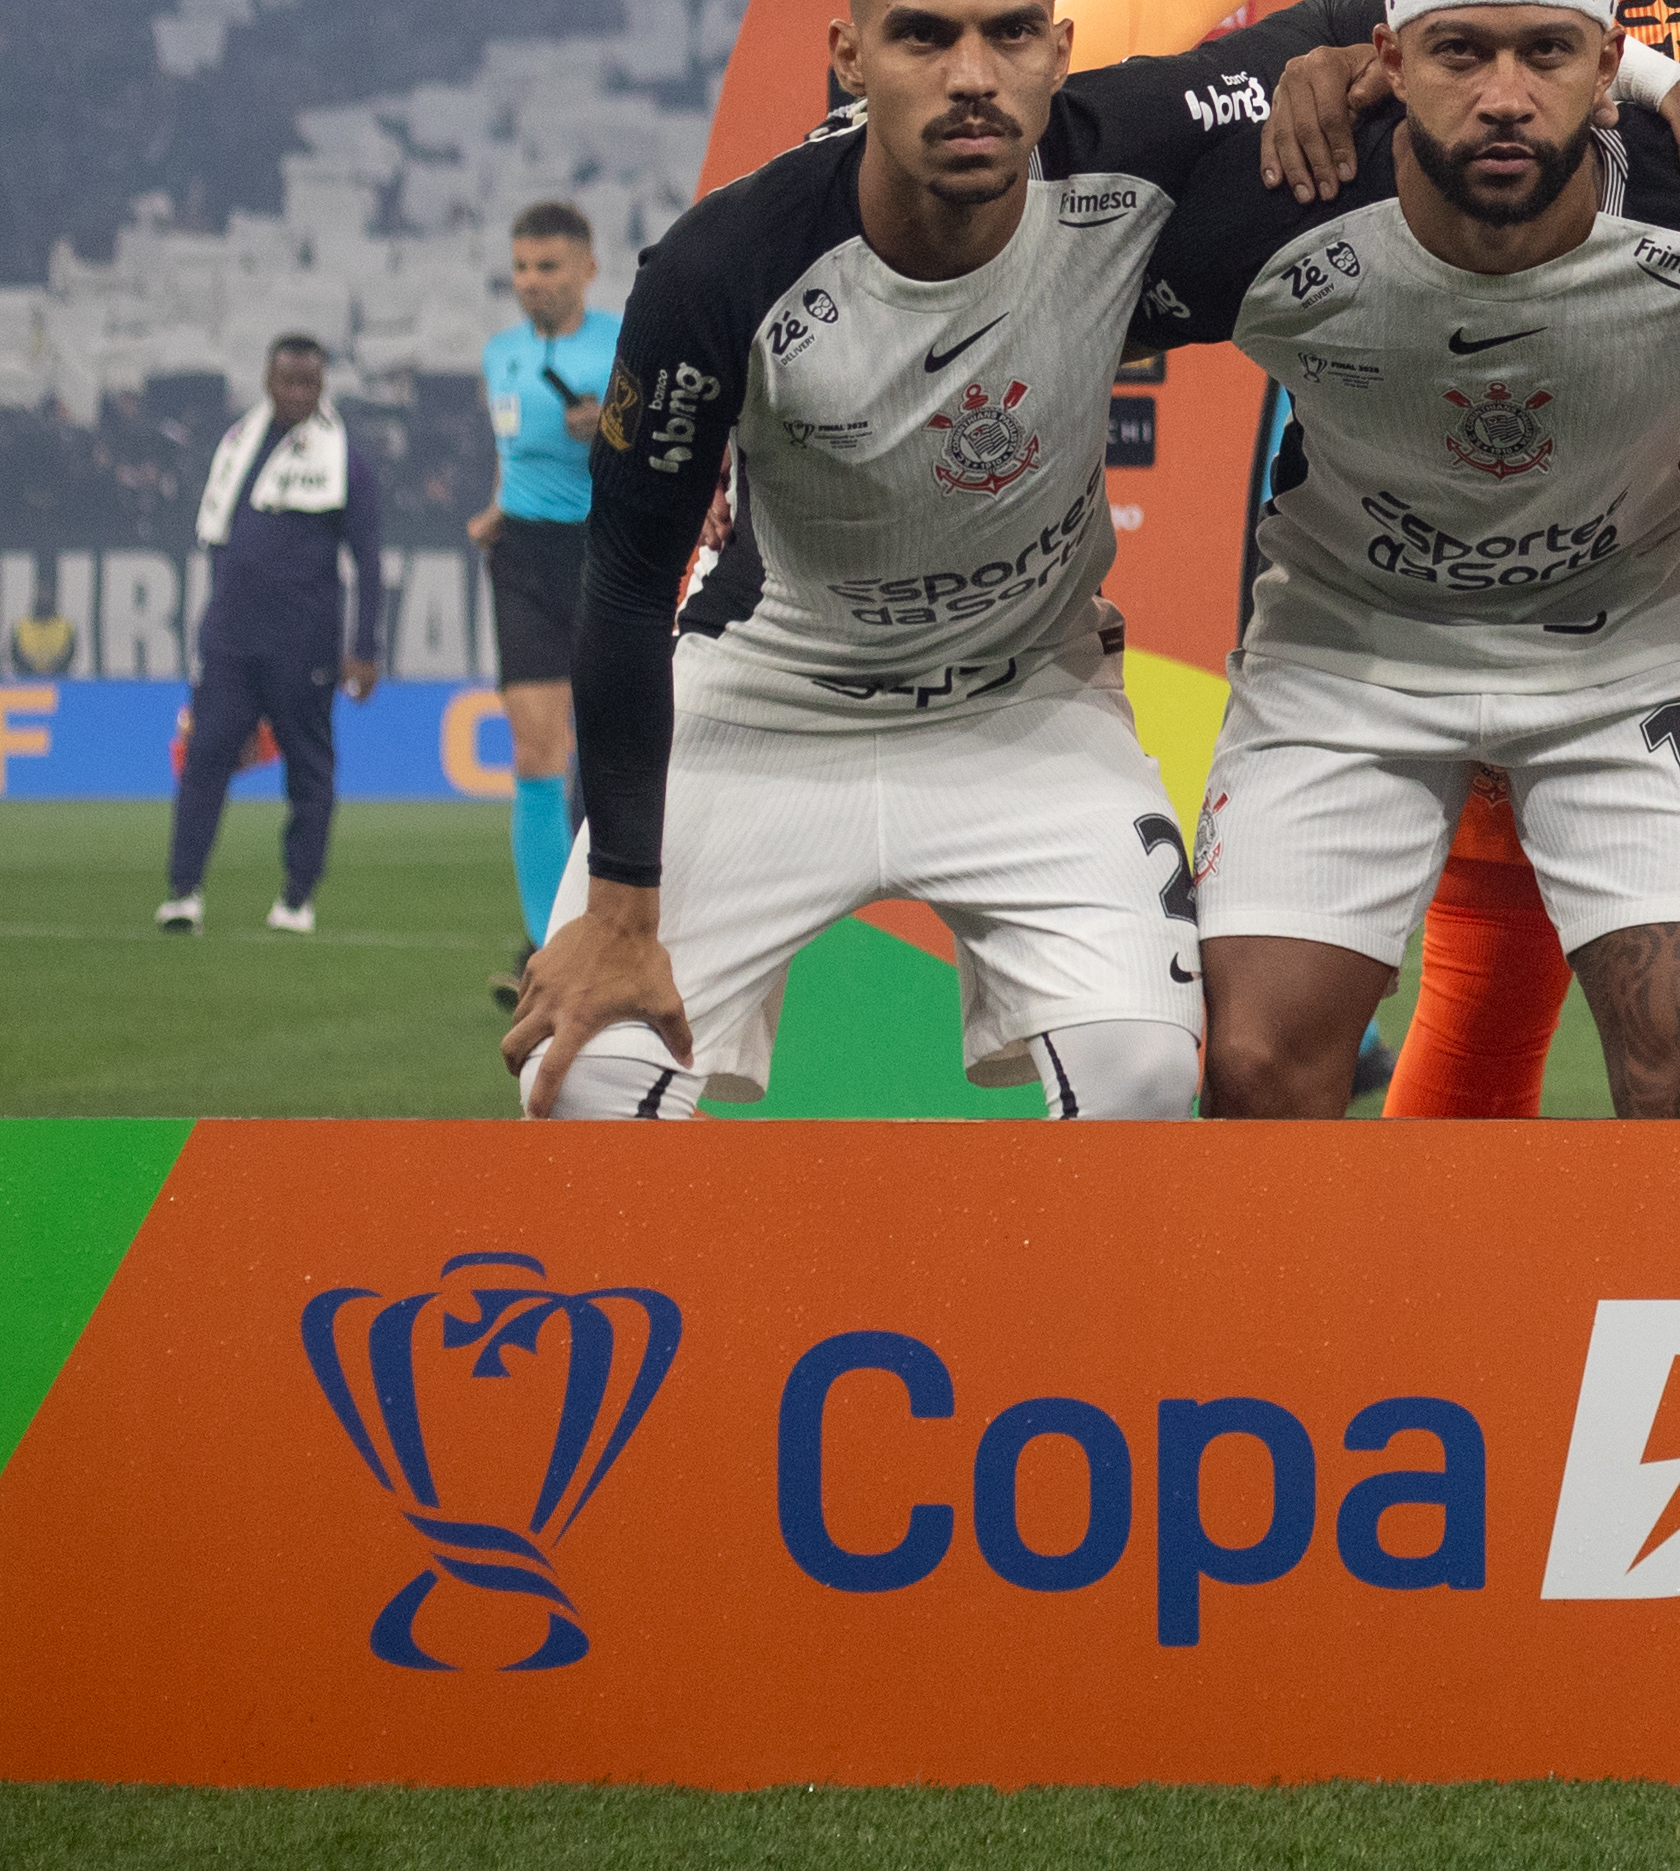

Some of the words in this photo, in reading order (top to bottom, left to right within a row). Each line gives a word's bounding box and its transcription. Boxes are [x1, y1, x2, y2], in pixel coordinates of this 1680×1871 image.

[1281, 258, 1329, 300] Zé
[1301, 282, 1335, 309] DELIVERY
[765, 309, 809, 357] Zé
[780, 333, 817, 367] DELIVERY
[648, 369, 669, 411] banco
[652, 361, 722, 444] bmg
[851, 604, 938, 628] da
[775, 1328, 1489, 1648] Copa
